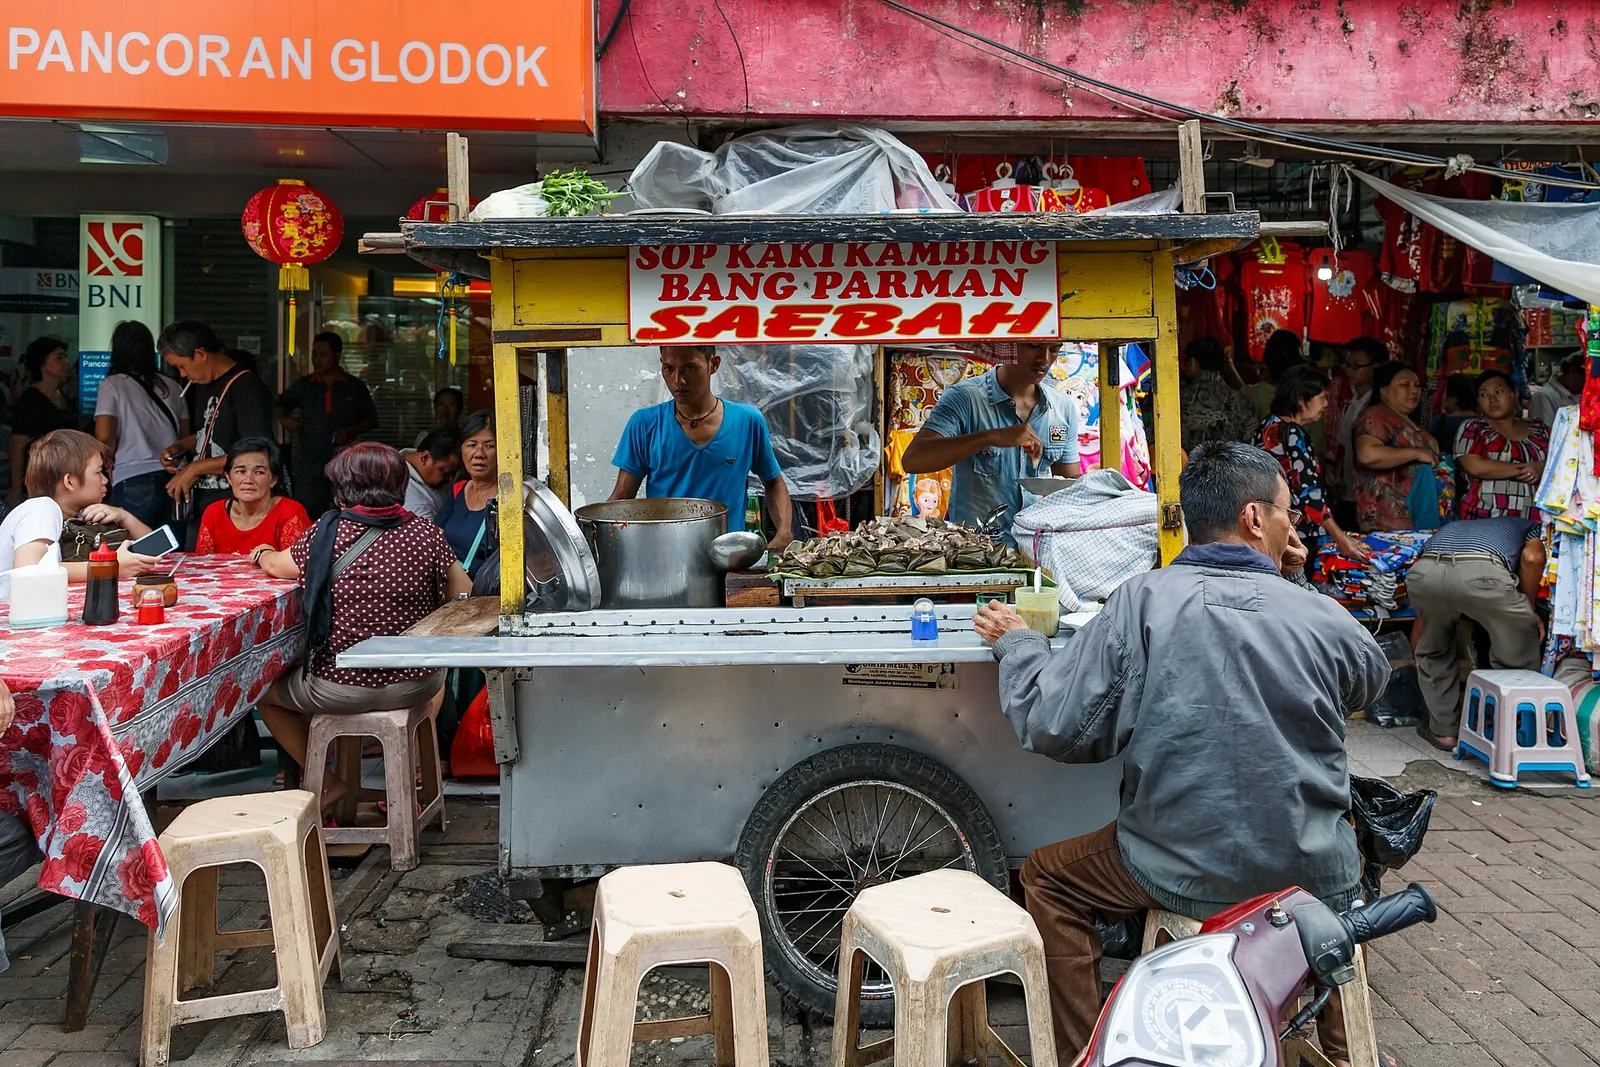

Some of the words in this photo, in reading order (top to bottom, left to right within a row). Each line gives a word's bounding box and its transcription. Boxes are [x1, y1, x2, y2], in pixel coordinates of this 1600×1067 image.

[9, 27, 312, 80] PANCORAN
[330, 38, 549, 87] GLODOK
[635, 244, 718, 270] SOP
[725, 243, 835, 269] KAKI
[843, 241, 1049, 268] KAMBING
[87, 284, 142, 309] BNI
[658, 271, 799, 302] BANG
[811, 268, 1029, 300] PARMAN
[634, 301, 1054, 341] SAEBAH
